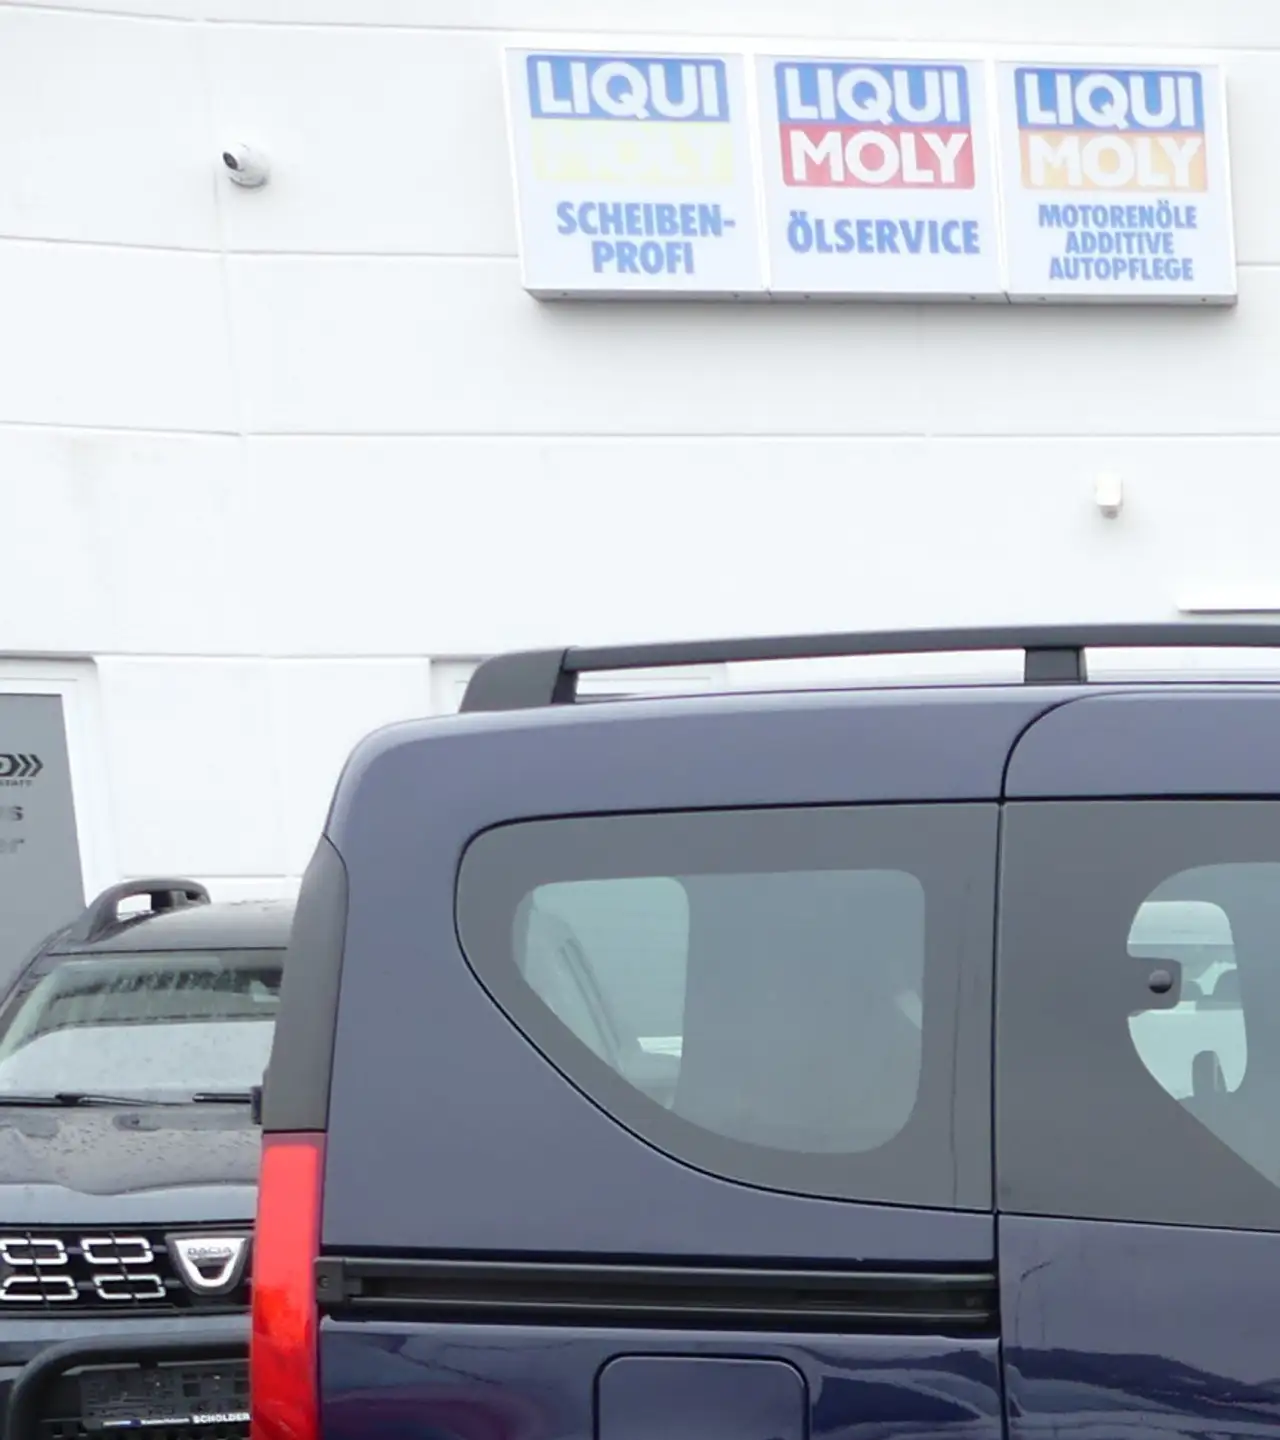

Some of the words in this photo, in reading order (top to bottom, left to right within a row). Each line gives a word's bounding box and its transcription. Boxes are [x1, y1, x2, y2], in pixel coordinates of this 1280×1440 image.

[538, 61, 720, 119] LIQUI
[786, 68, 962, 125] LIQUI
[1026, 74, 1194, 130] LIQUI
[791, 132, 968, 184] MOLY
[1029, 138, 1200, 188] MOLY
[556, 201, 735, 237] SCHEIBEN-
[787, 210, 980, 254] ÖLSERVICE
[1039, 199, 1197, 229] MOTORENÖLE
[592, 242, 695, 274] PROFI
[1065, 231, 1174, 255] ADDITIVE
[1049, 256, 1193, 282] AUTOPFLEGE
